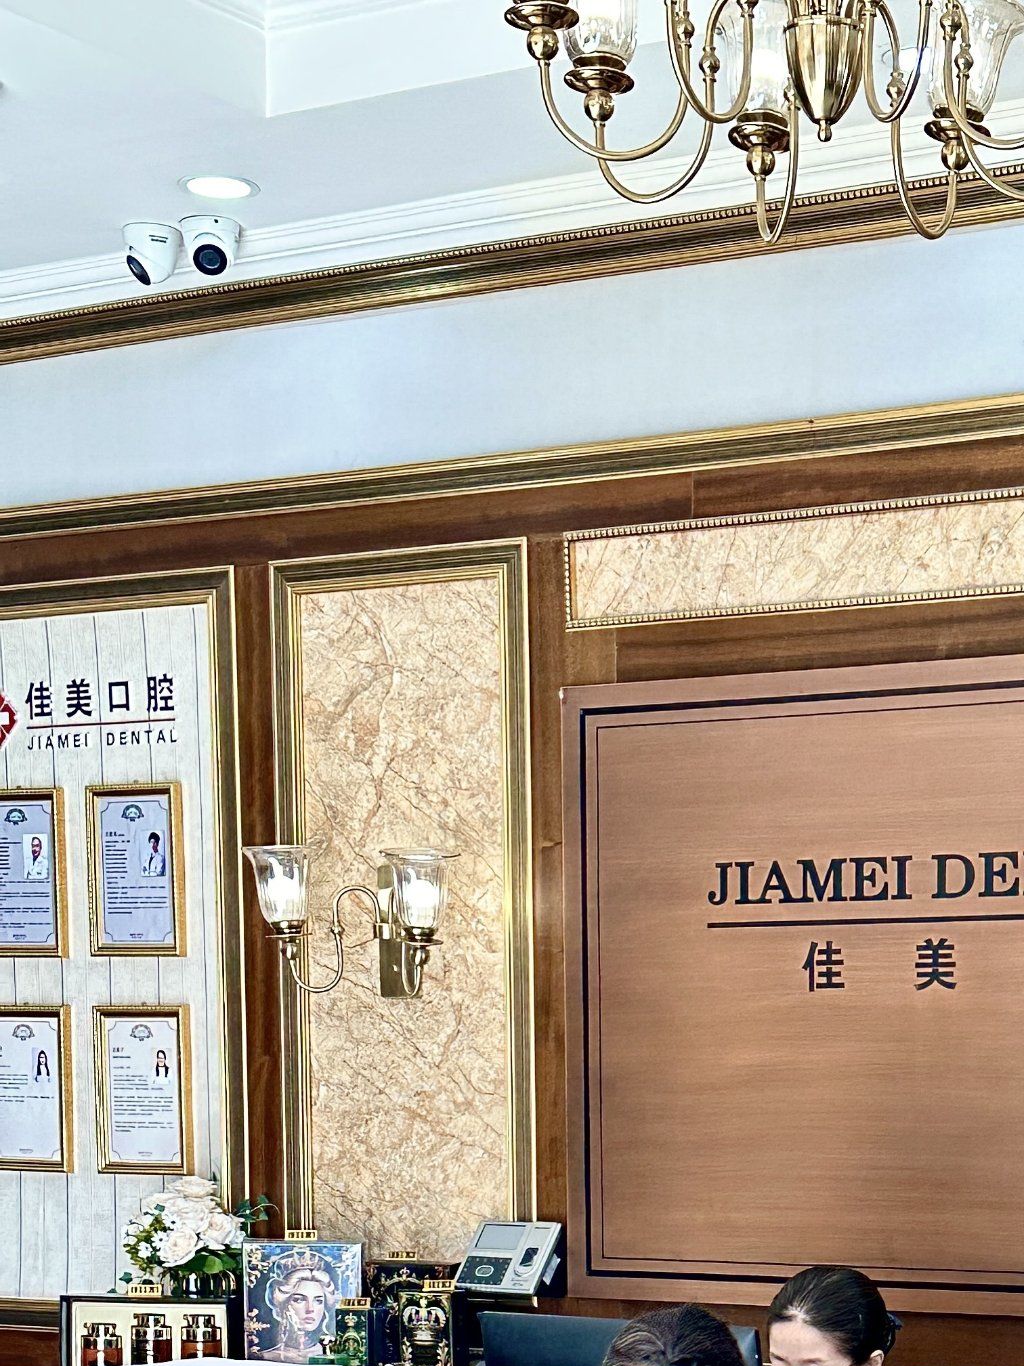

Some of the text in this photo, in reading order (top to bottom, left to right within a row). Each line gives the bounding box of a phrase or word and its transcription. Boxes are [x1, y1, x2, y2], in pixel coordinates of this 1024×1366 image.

[25, 673, 174, 719] 佳美口腔
[28, 726, 177, 750] JIAMEI DENTAL
[708, 855, 913, 905] JIAMEI
